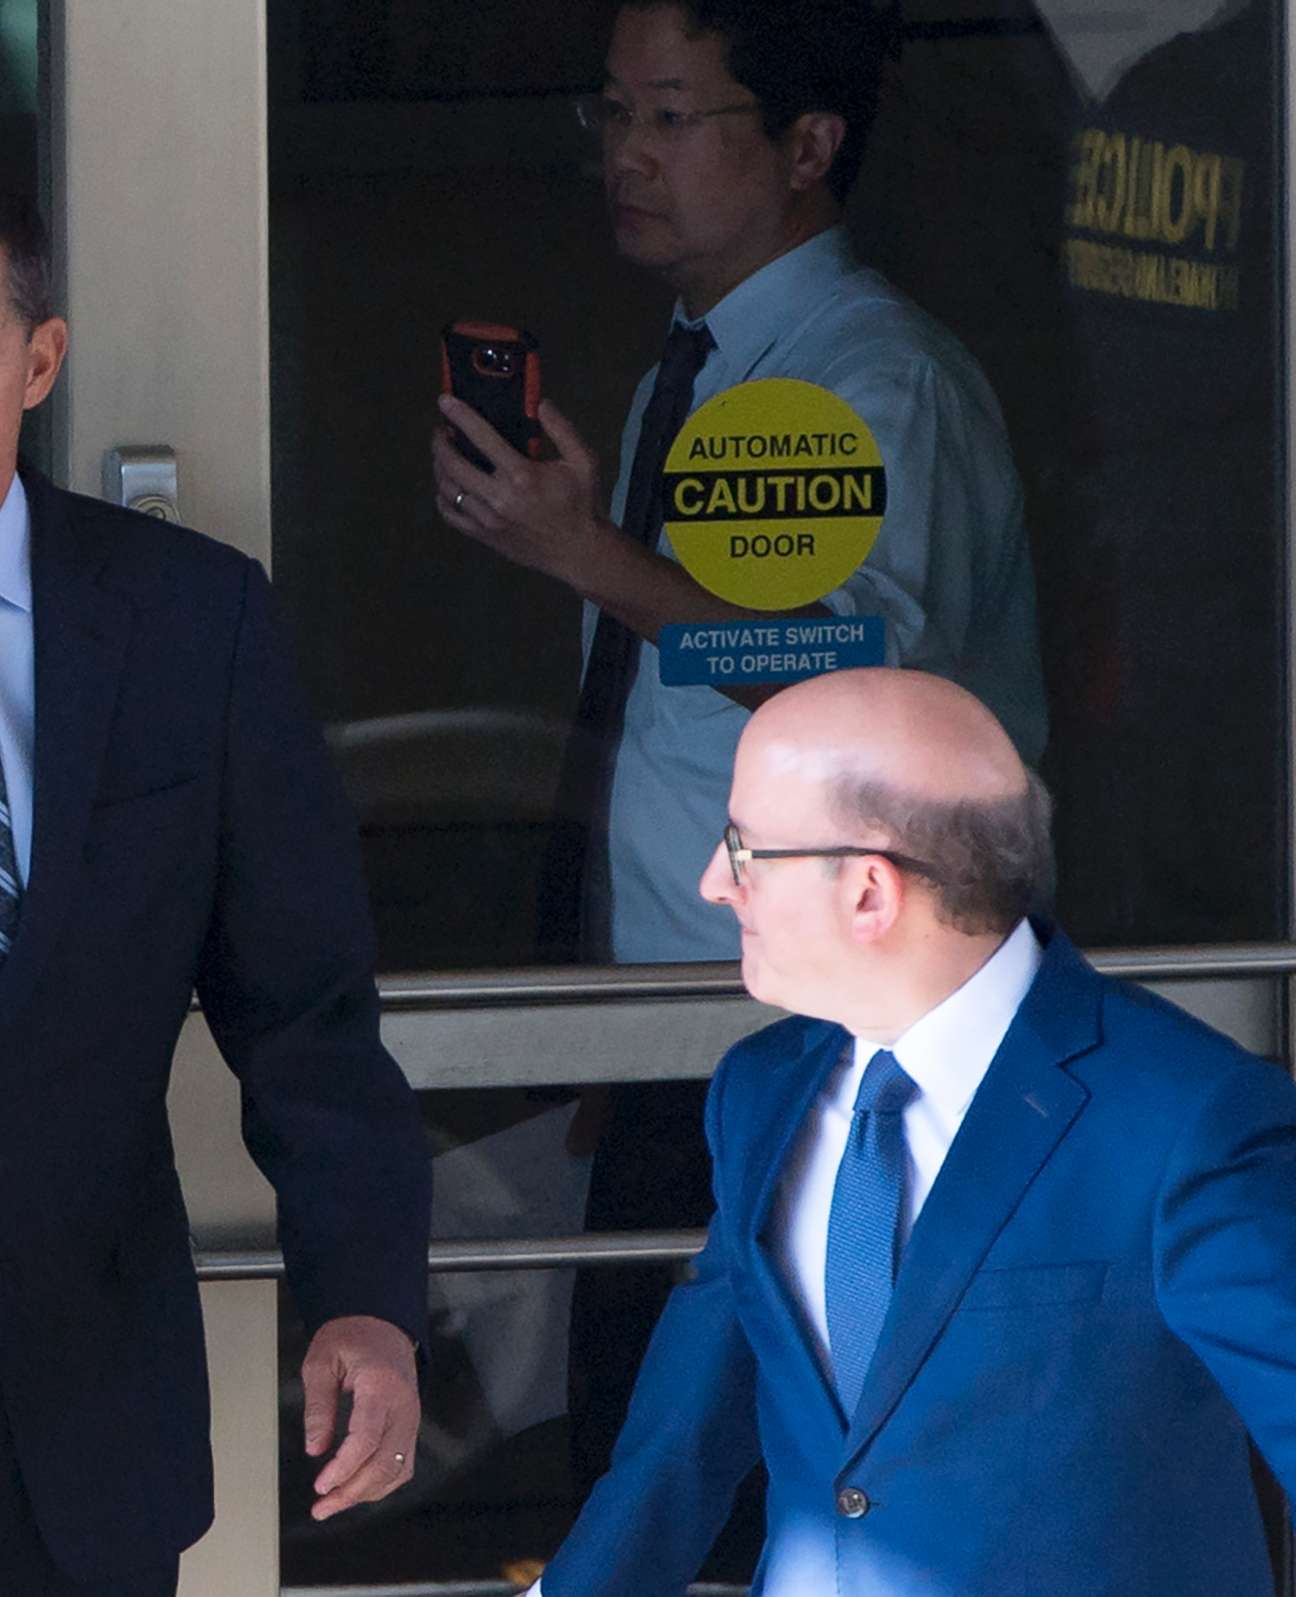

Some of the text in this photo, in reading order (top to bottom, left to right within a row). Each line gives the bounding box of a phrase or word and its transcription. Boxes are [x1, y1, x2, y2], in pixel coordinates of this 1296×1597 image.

[689, 433, 858, 460] AUTOMATIC
[674, 474, 872, 515] CAUTION
[730, 534, 815, 558] DOOR
[680, 623, 864, 650] ACTIVATE SWITCH
[707, 651, 837, 674] TO OPERATE
